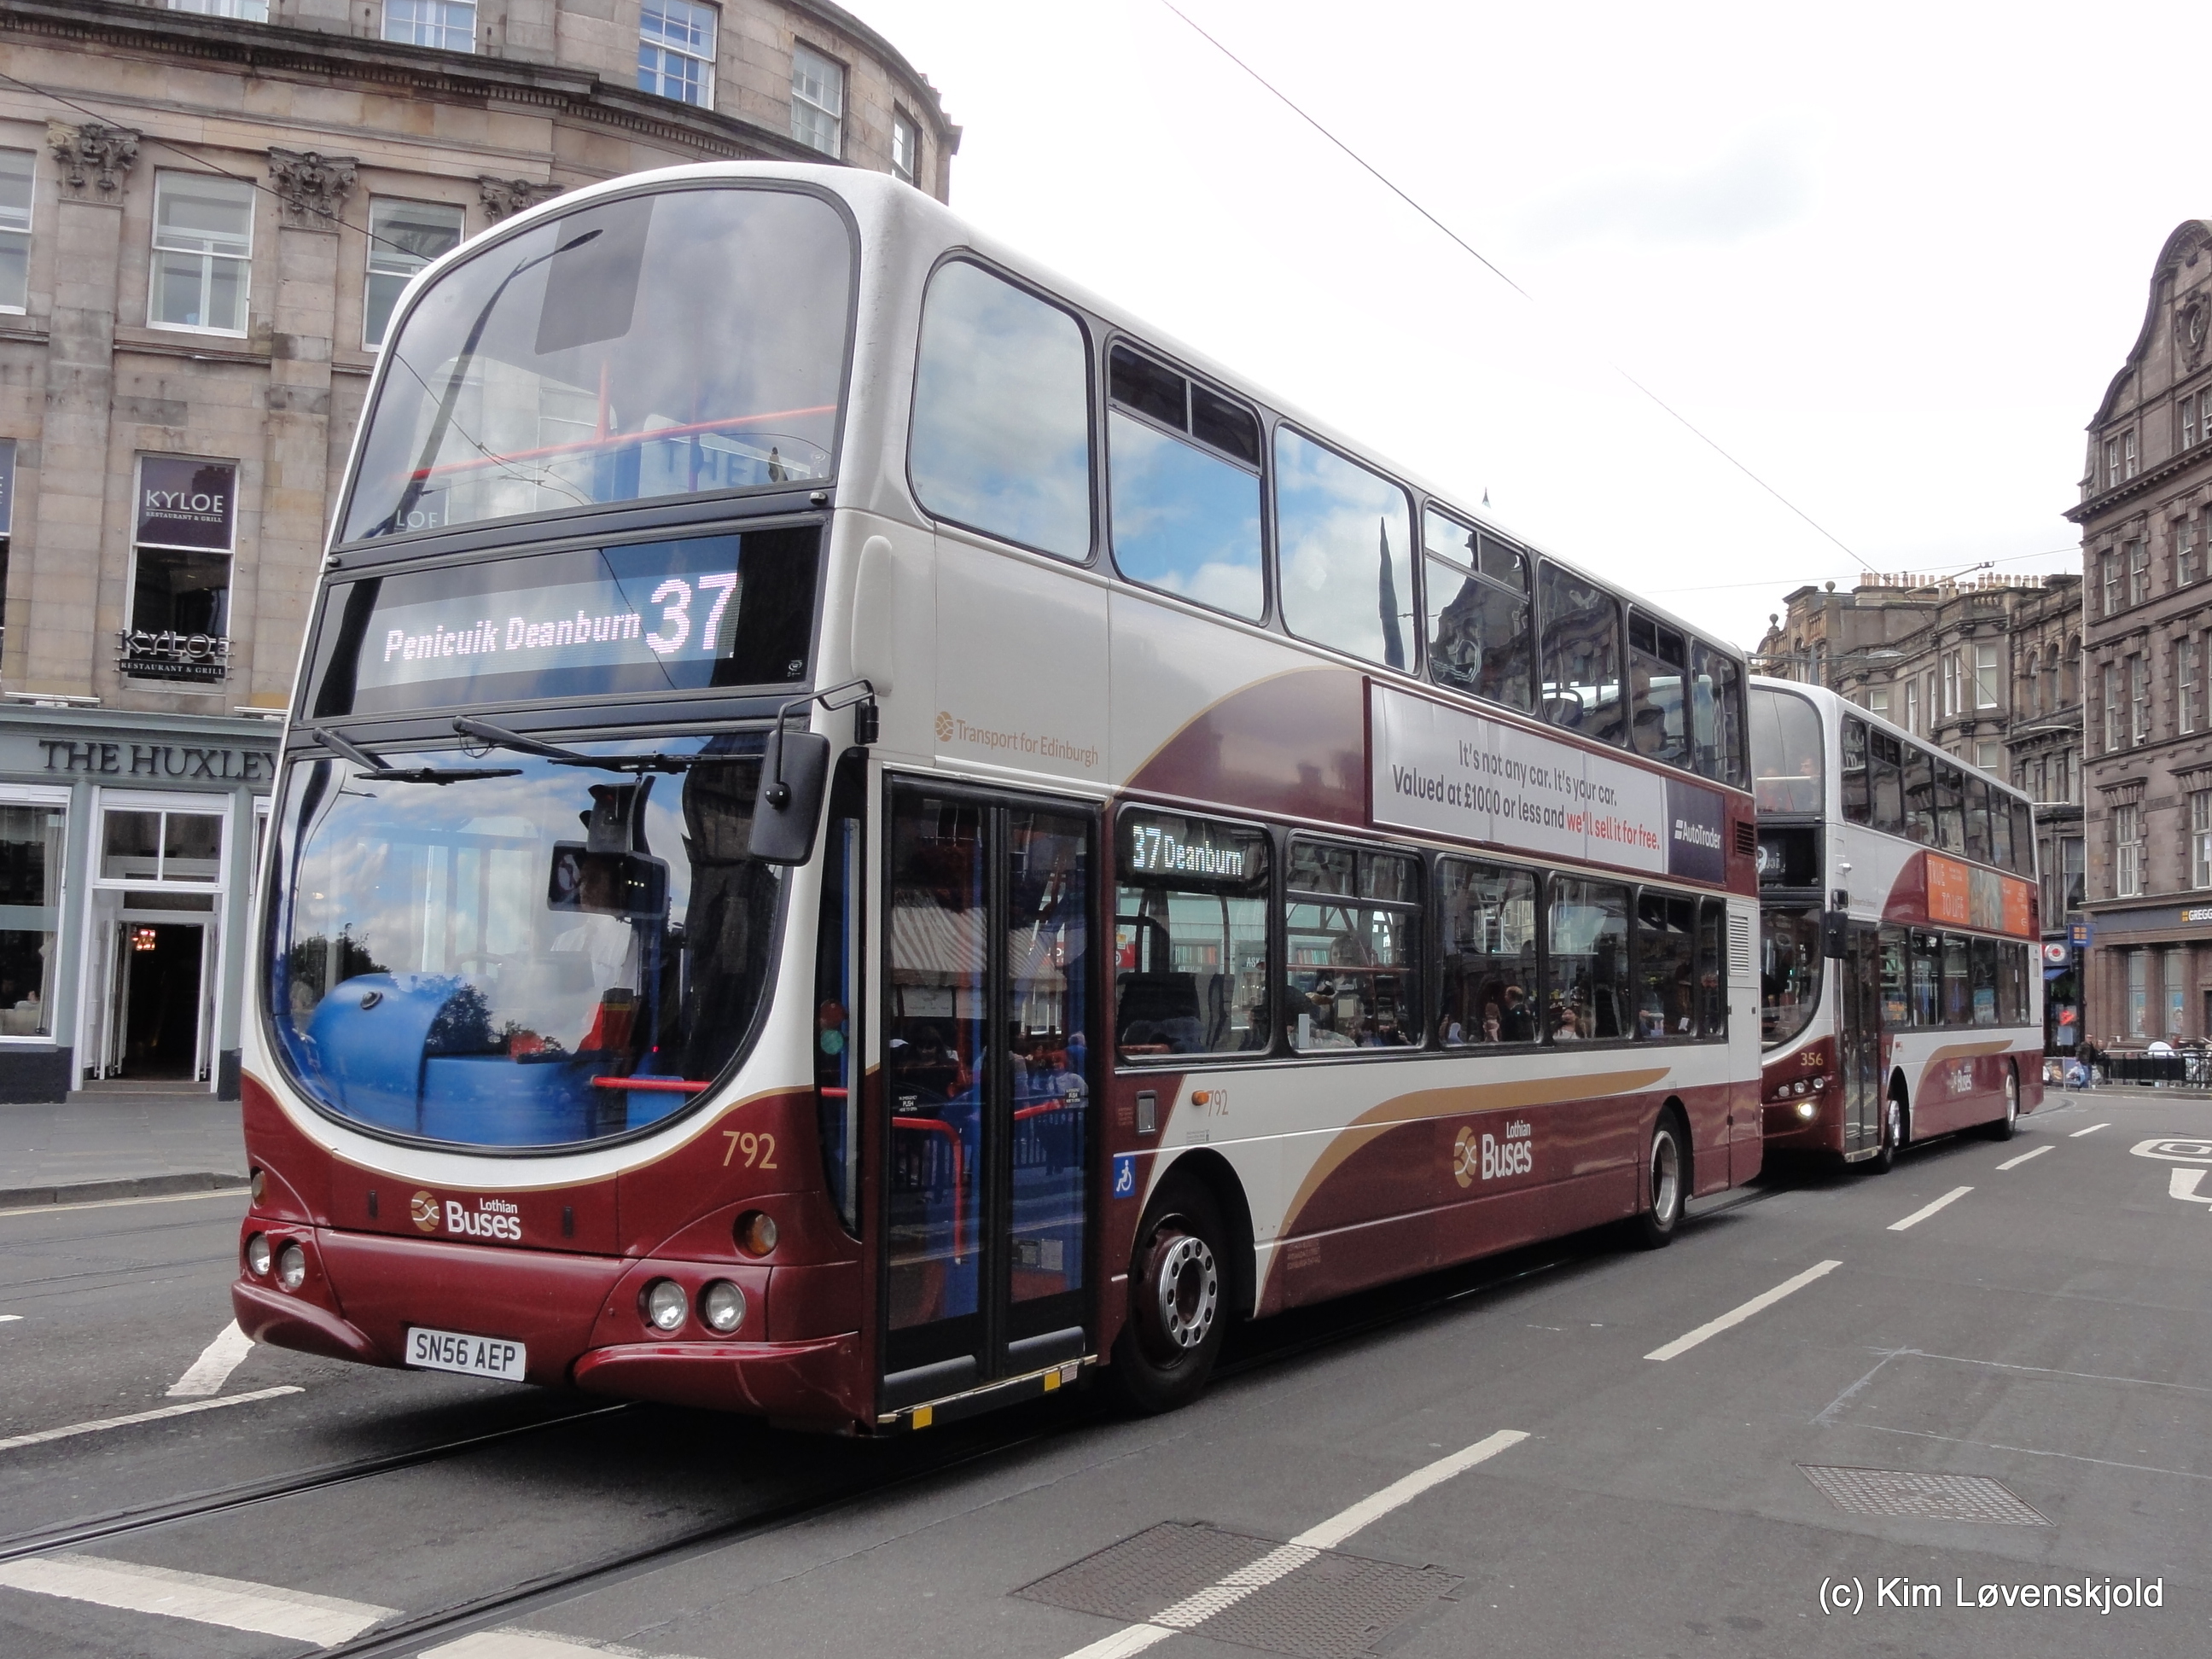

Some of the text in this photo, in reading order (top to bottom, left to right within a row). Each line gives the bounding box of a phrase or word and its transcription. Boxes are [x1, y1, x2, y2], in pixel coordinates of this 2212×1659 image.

[146, 490, 224, 513] KYLOE
[146, 512, 192, 521] RESTAURANT
[646, 573, 737, 654] 37
[122, 628, 229, 658] KYLOE
[384, 609, 641, 661] Penicuik Deanburn
[121, 661, 183, 672] RESTAURANT
[39, 739, 119, 772] THE
[957, 719, 1098, 767] Transport for Edinburgh
[1459, 740, 1617, 806] It's not any car. It's your car.
[1393, 764, 1660, 851] Valued at £1000 or less and we'll sell it for free.
[1133, 825, 1242, 876] 37 Deanburn
[1682, 821, 1721, 849] AutoTrader
[1801, 1052, 1824, 1066] 356
[1958, 1068, 1972, 1092] Buses
[1208, 1089, 1229, 1117] 792
[1506, 1120, 1531, 1138] Lothian
[723, 1131, 777, 1169] 792
[1482, 1133, 1532, 1180] Buses
[445, 1200, 521, 1240] Buses
[480, 1197, 518, 1214] Lothian
[416, 1333, 515, 1372] SN56 AEP
